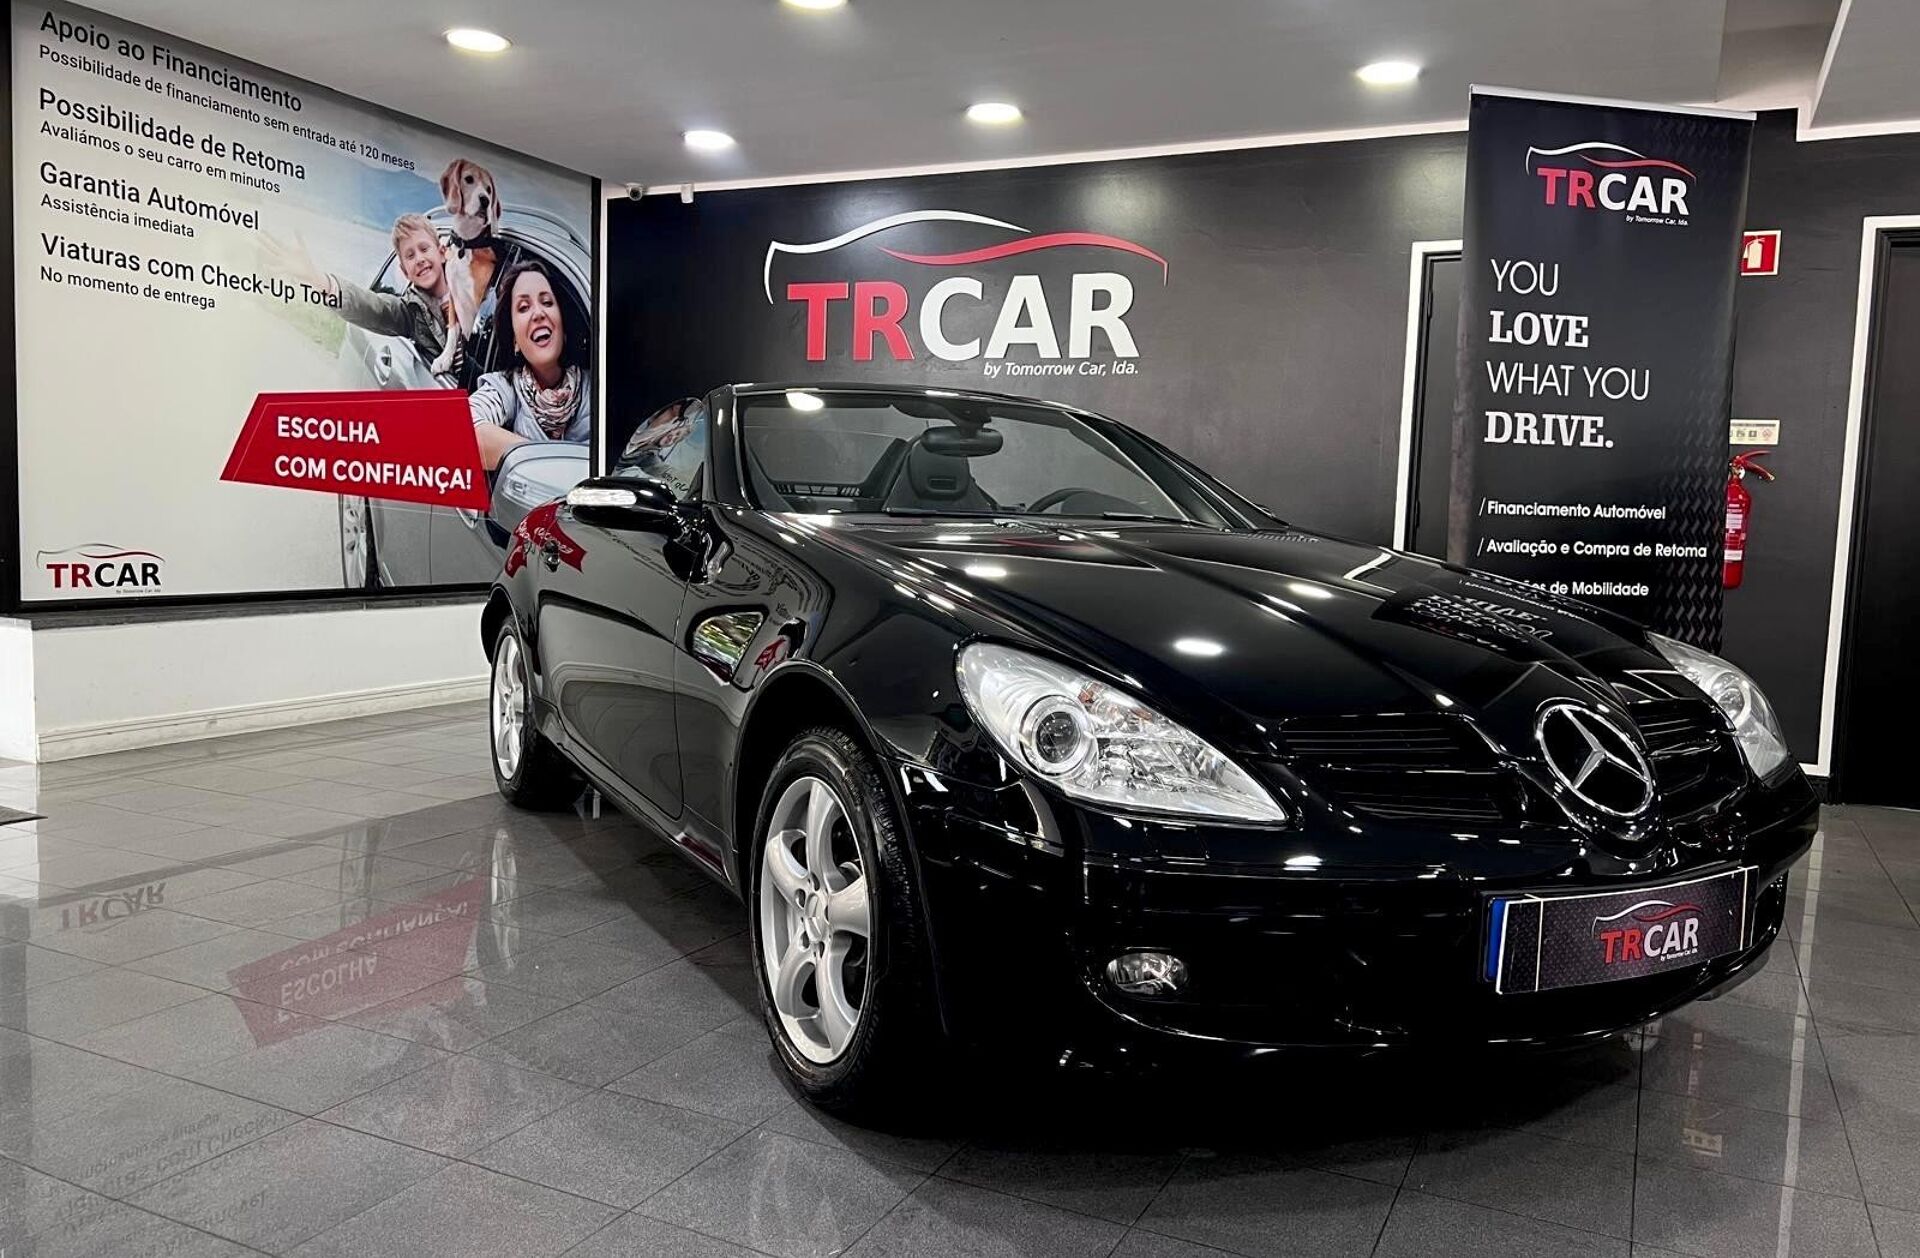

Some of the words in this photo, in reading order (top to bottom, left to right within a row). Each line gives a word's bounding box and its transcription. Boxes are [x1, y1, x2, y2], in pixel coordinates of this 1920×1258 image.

[41, 11, 110, 51] Apoio
[118, 35, 145, 61] ao
[153, 46, 302, 112] Financiamento
[40, 45, 141, 87] Possibilidade
[145, 75, 162, 94] de
[167, 82, 260, 123] financiamento
[264, 116, 289, 133] sem
[293, 123, 336, 148] entrada
[339, 136, 356, 153] até
[360, 144, 378, 160] 120
[382, 152, 415, 171] meses
[40, 88, 195, 150] Possibilidade
[201, 134, 226, 158] de
[233, 142, 305, 180] Retoma
[40, 120, 120, 153] Avaliámos
[124, 144, 134, 155] o
[138, 147, 163, 164] seu
[167, 154, 202, 173] carro
[206, 165, 226, 181] em
[230, 169, 281, 194] minutos
[40, 162, 139, 202] Garantia
[148, 187, 259, 230] Automóvel
[1537, 168, 1689, 216] TRCAR
[41, 194, 130, 226] Assistência
[134, 212, 195, 238] imediata
[41, 233, 140, 271] Viaturas
[148, 259, 194, 282] com
[201, 264, 295, 302] Check-Up
[301, 283, 343, 309] Total
[41, 266, 62, 284] No
[68, 275, 139, 297] momento
[143, 284, 161, 300] de
[165, 289, 216, 309] entrega
[1491, 259, 1559, 296] YOU
[787, 272, 1140, 361] TRCAR
[1489, 311, 1588, 348] LOVE
[984, 362, 1001, 378] by
[1005, 362, 1075, 375] Tomorrow
[1079, 362, 1106, 376] Car,
[1486, 361, 1575, 396] WHAT
[1583, 366, 1649, 400] YOU
[277, 416, 380, 445] ESCOLHA
[1484, 411, 1614, 448] DRIVE.
[275, 456, 326, 481] COM
[333, 459, 472, 493] CONFIANÇA!
[1593, 505, 1666, 520] Automóvel
[1561, 544, 1569, 554] e
[1574, 541, 1629, 558] Compra
[1633, 542, 1651, 556] de
[1656, 544, 1707, 558] Retoma
[46, 562, 161, 588] TRCAR
[1550, 581, 1568, 595] de
[1572, 581, 1649, 596] Mobilidade
[1601, 918, 1699, 964] TRCAR
